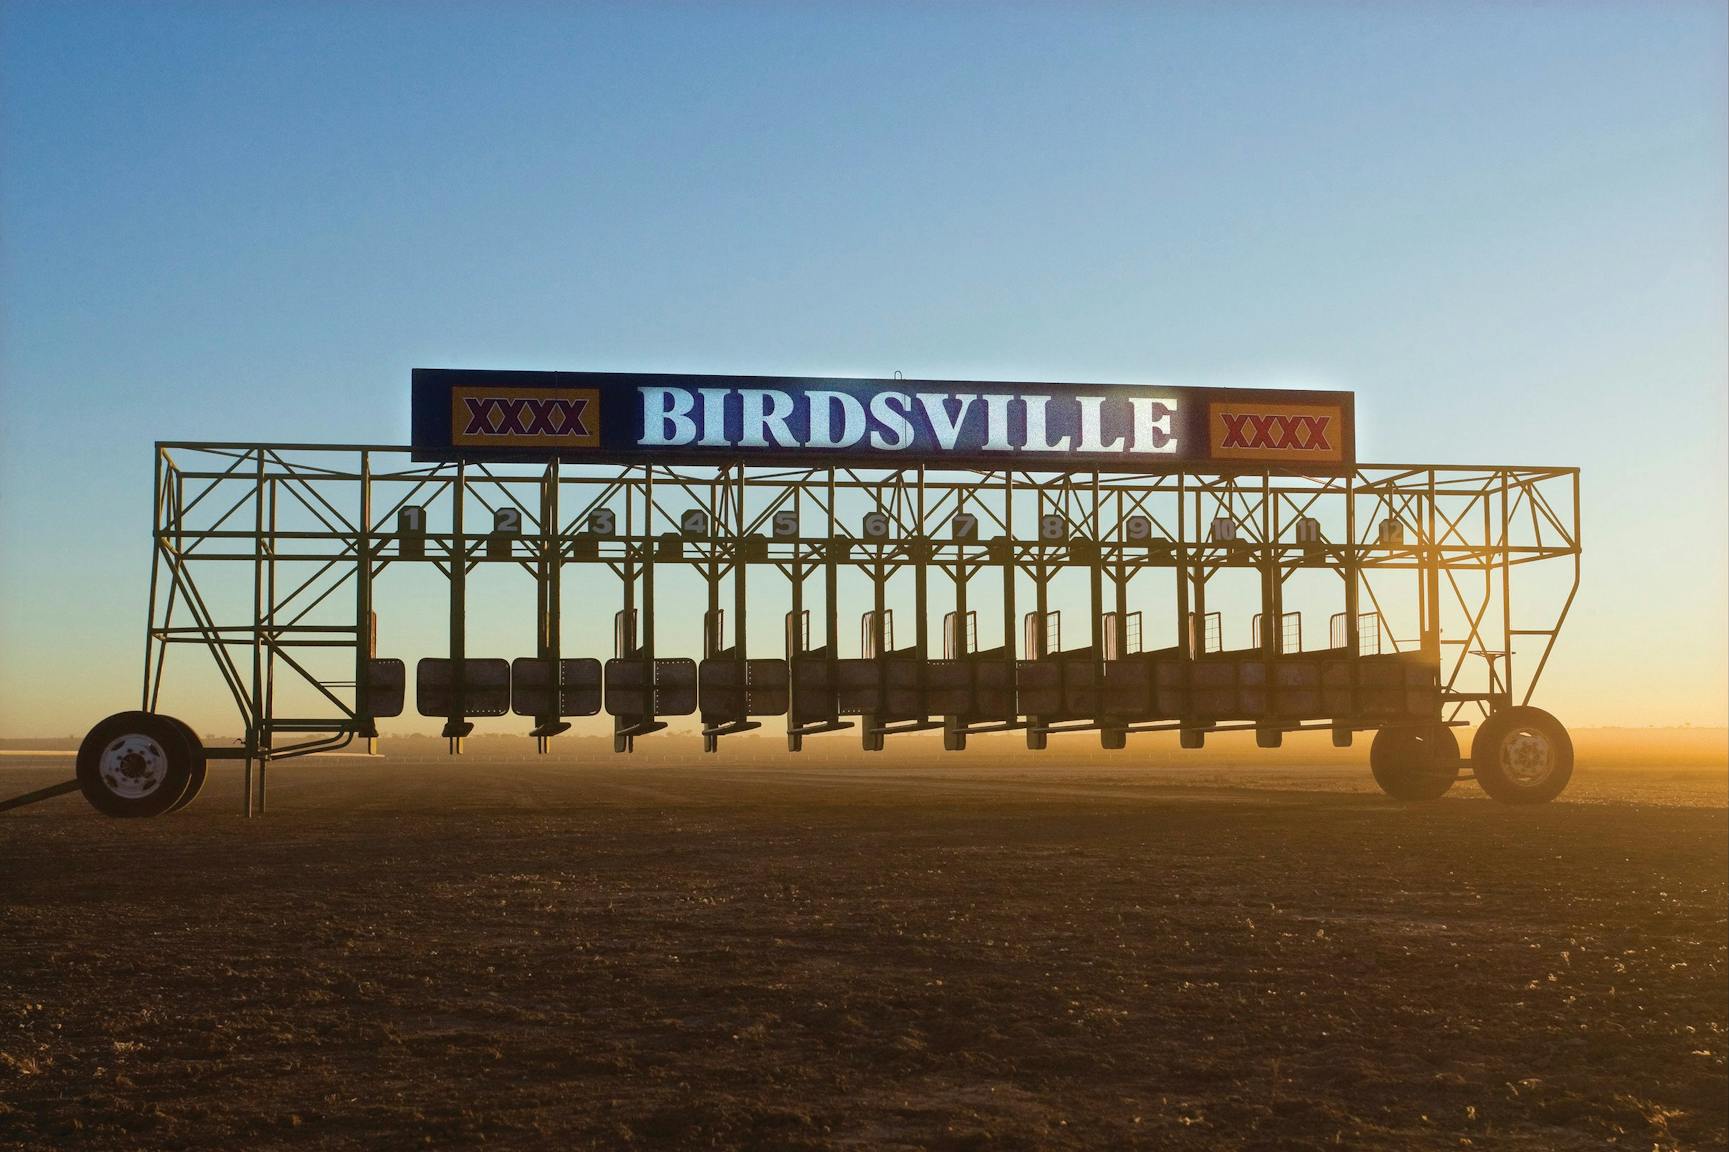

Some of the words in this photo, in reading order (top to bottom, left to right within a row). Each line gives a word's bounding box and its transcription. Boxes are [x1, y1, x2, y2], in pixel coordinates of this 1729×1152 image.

[463, 398, 590, 437] XXXX
[637, 385, 1178, 454] BIRDSVILLE
[1221, 413, 1330, 450] XXXX
[404, 508, 419, 530] 1
[496, 512, 519, 532] 2
[591, 513, 613, 534] 3
[684, 512, 707, 533] 4
[775, 512, 797, 535] 5
[866, 513, 887, 535] 6
[955, 516, 976, 537] 7
[1042, 516, 1063, 539] 8
[1128, 517, 1149, 540] 9
[1213, 520, 1235, 540] 10
[1300, 520, 1318, 541] 11
[1383, 522, 1403, 542] 12
